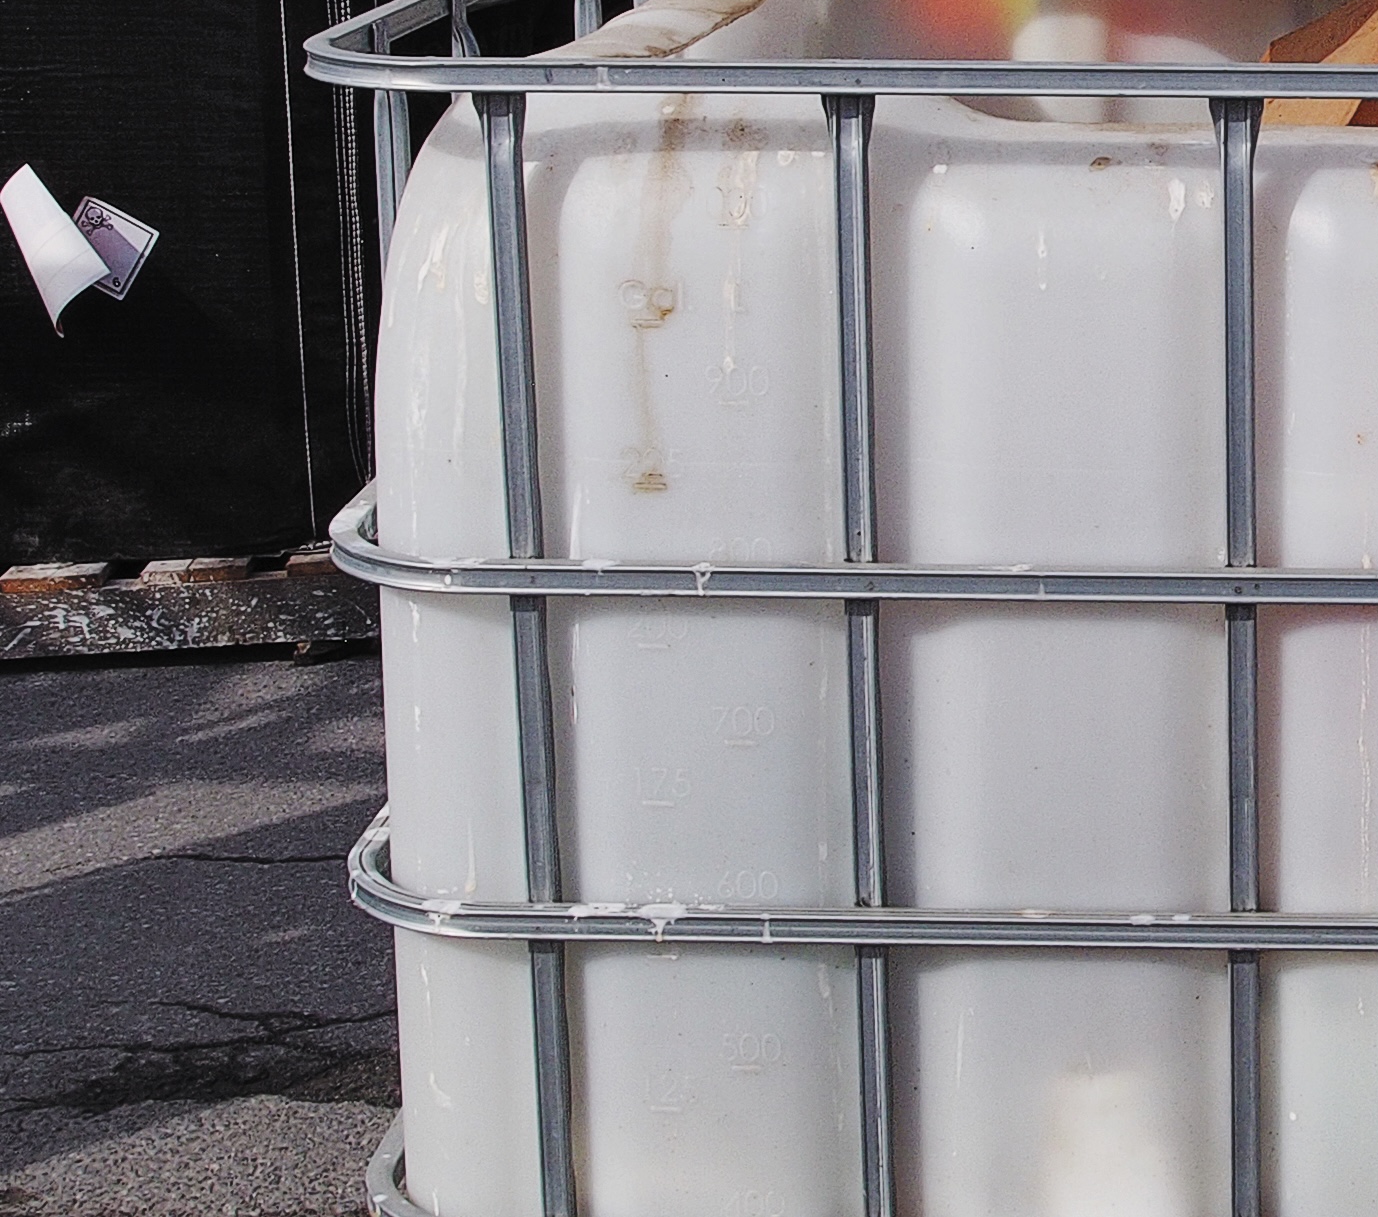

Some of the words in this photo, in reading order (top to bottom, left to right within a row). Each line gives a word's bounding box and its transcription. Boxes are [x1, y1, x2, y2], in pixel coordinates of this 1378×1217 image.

[112, 276, 122, 288] 6
[704, 365, 769, 397] 900
[711, 705, 775, 736] 700
[633, 766, 692, 798] 175
[717, 869, 778, 900] 600
[718, 1033, 781, 1063] 500
